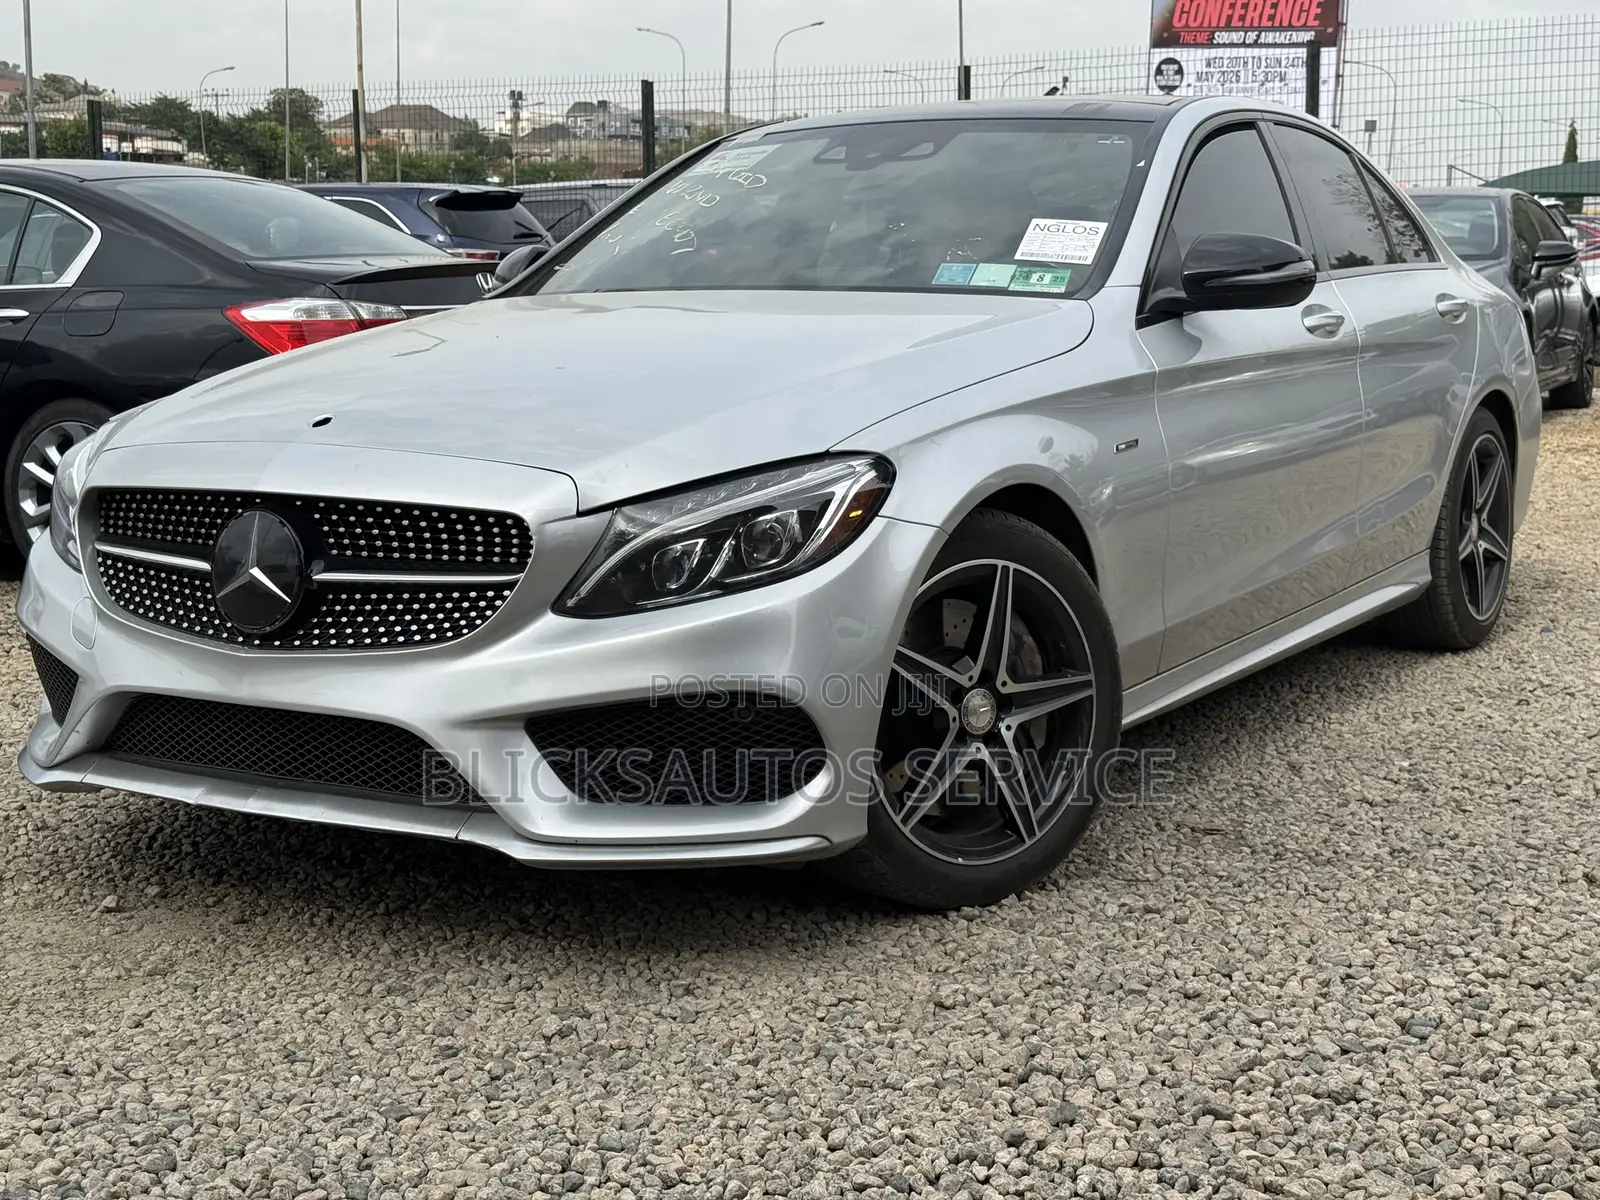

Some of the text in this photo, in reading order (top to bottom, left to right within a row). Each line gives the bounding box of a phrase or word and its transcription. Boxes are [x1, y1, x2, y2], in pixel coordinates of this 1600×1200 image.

[1172, 0, 1324, 28] CONFERENCE
[1179, 31, 1212, 44] THEME:
[1213, 31, 1244, 44] SOUND
[1245, 31, 1259, 44] OF
[1205, 57, 1224, 69] WED
[1226, 56, 1249, 69] 20TH
[1251, 56, 1262, 69] TO
[1264, 56, 1283, 69] SUN
[1196, 71, 1214, 83] MAY
[1217, 70, 1241, 83] 2026
[1032, 223, 1100, 236] NGLOS
[1036, 273, 1046, 283] 8
[1052, 275, 1066, 283] 25
